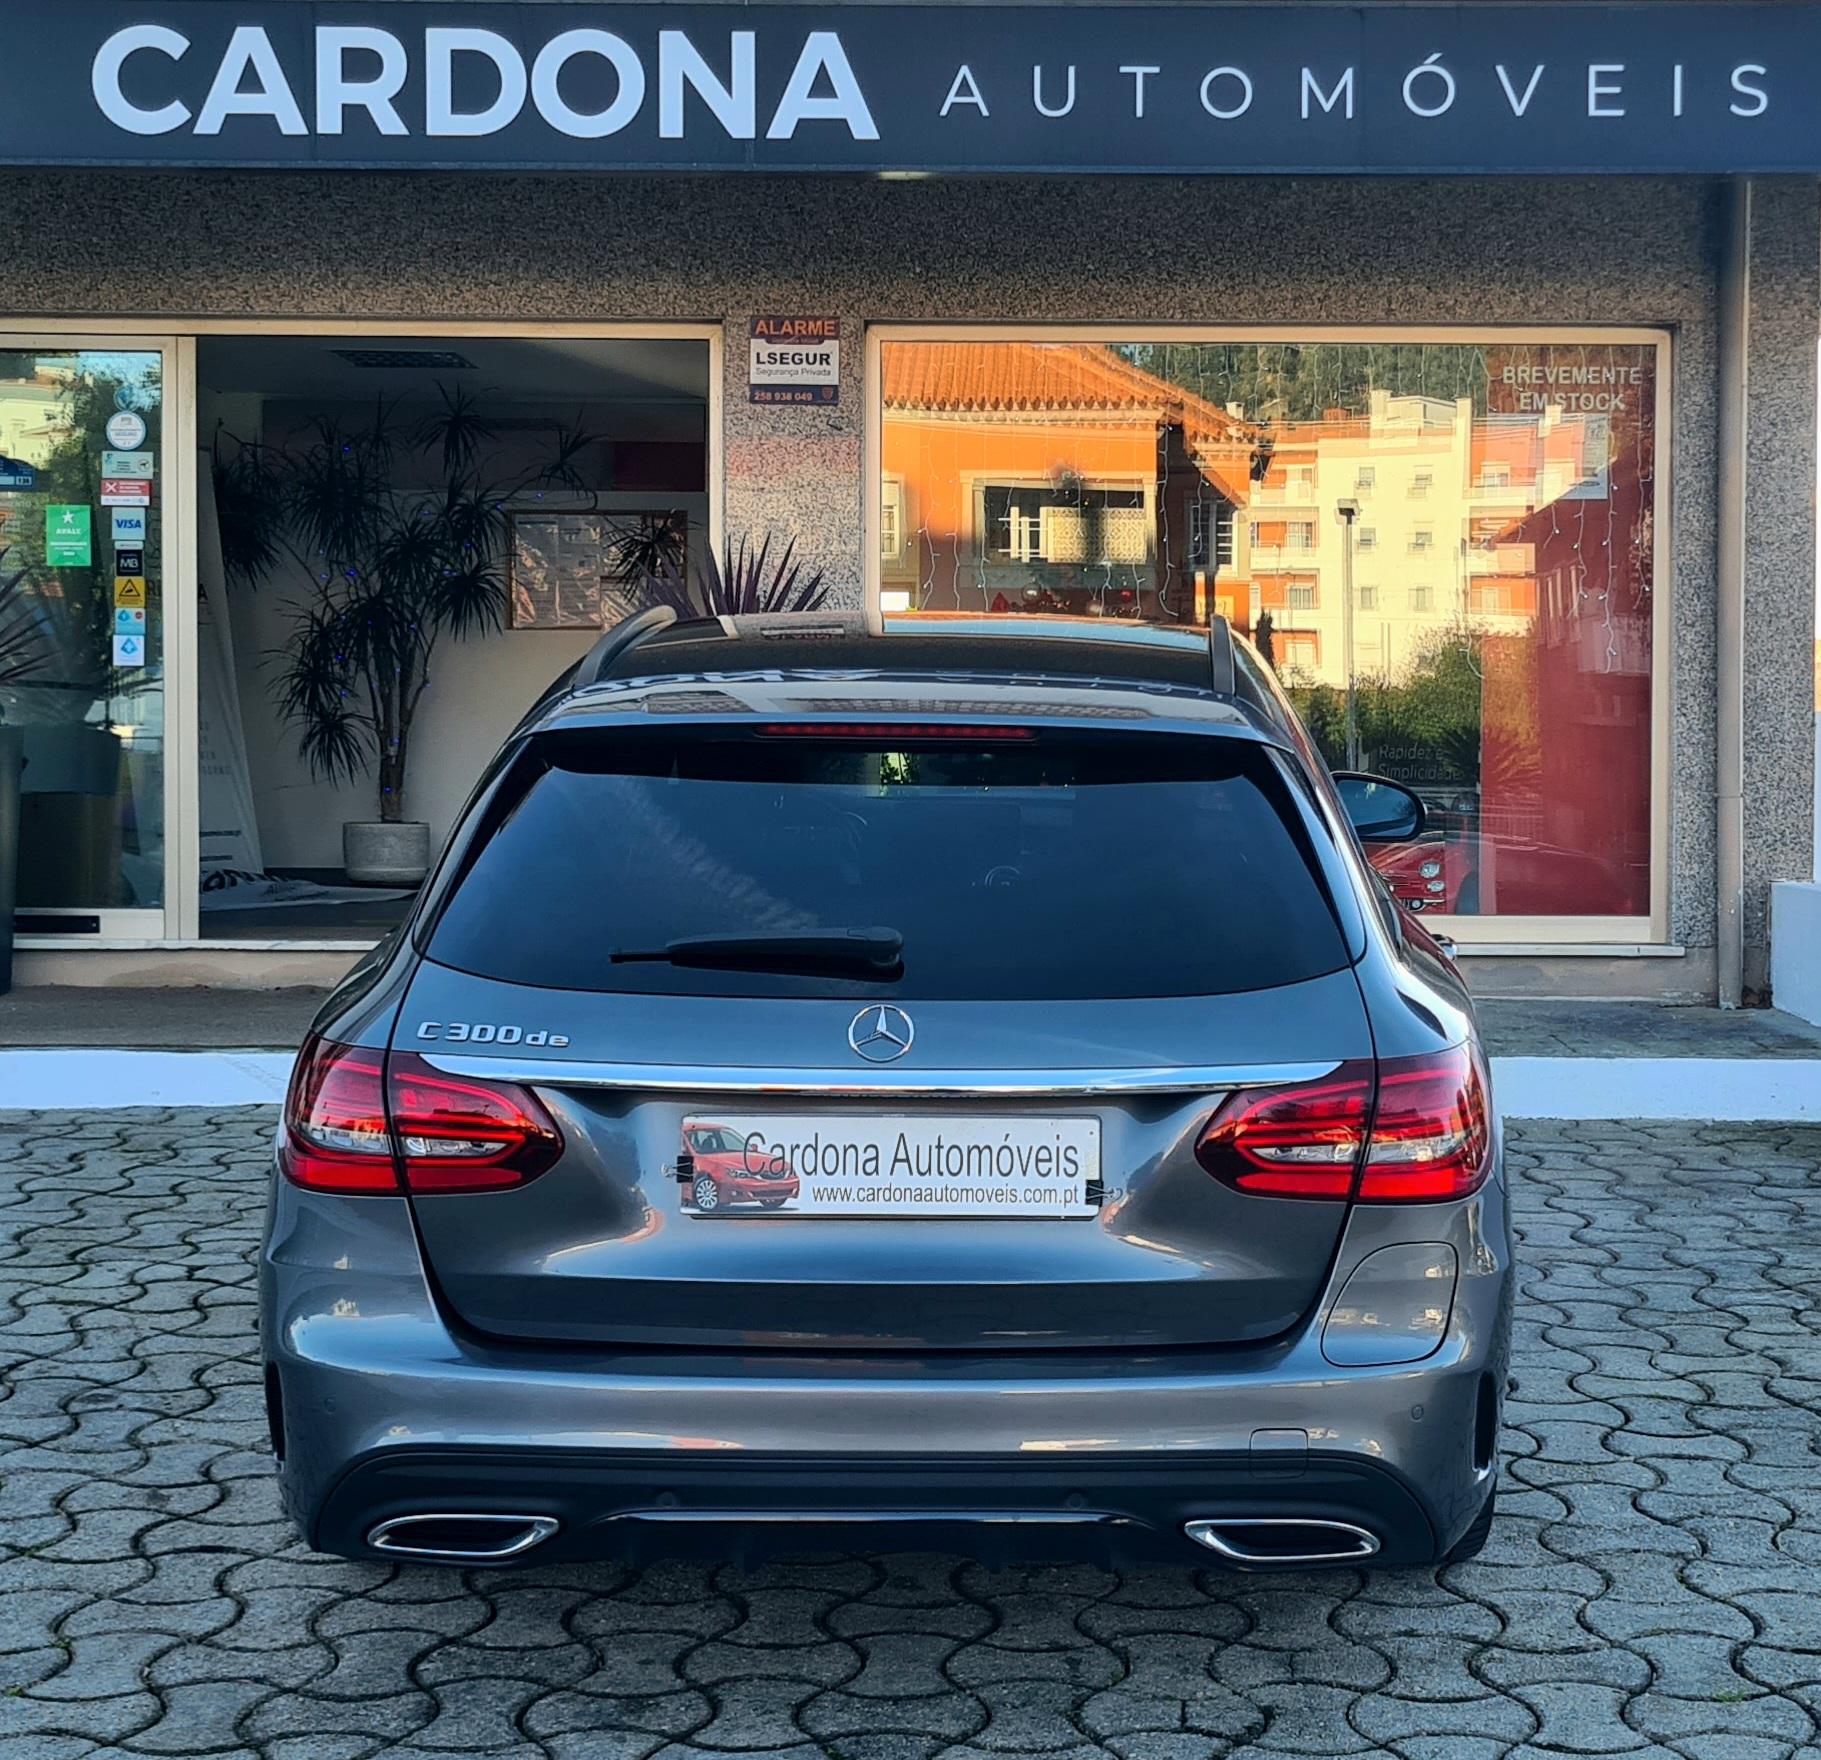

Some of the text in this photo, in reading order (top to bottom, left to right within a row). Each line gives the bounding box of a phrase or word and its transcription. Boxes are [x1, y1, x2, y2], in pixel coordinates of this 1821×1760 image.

[92, 25, 1768, 140] CARDONA AUTOMÓVEIS
[755, 320, 836, 336] ALARME
[756, 351, 832, 366] LSEGUR
[756, 367, 831, 377] Segurança Privada
[1502, 366, 1643, 385] BREVEMENTE
[1519, 393, 1626, 411] EM STOCK
[115, 519, 142, 528] VISA
[1379, 743, 1432, 760] Rapidez
[1378, 763, 1464, 781] Simplicidade
[743, 1131, 1079, 1178] Cardona Automóveis
[812, 1183, 1079, 1206] www.cardonaautomoveis.com.pt
